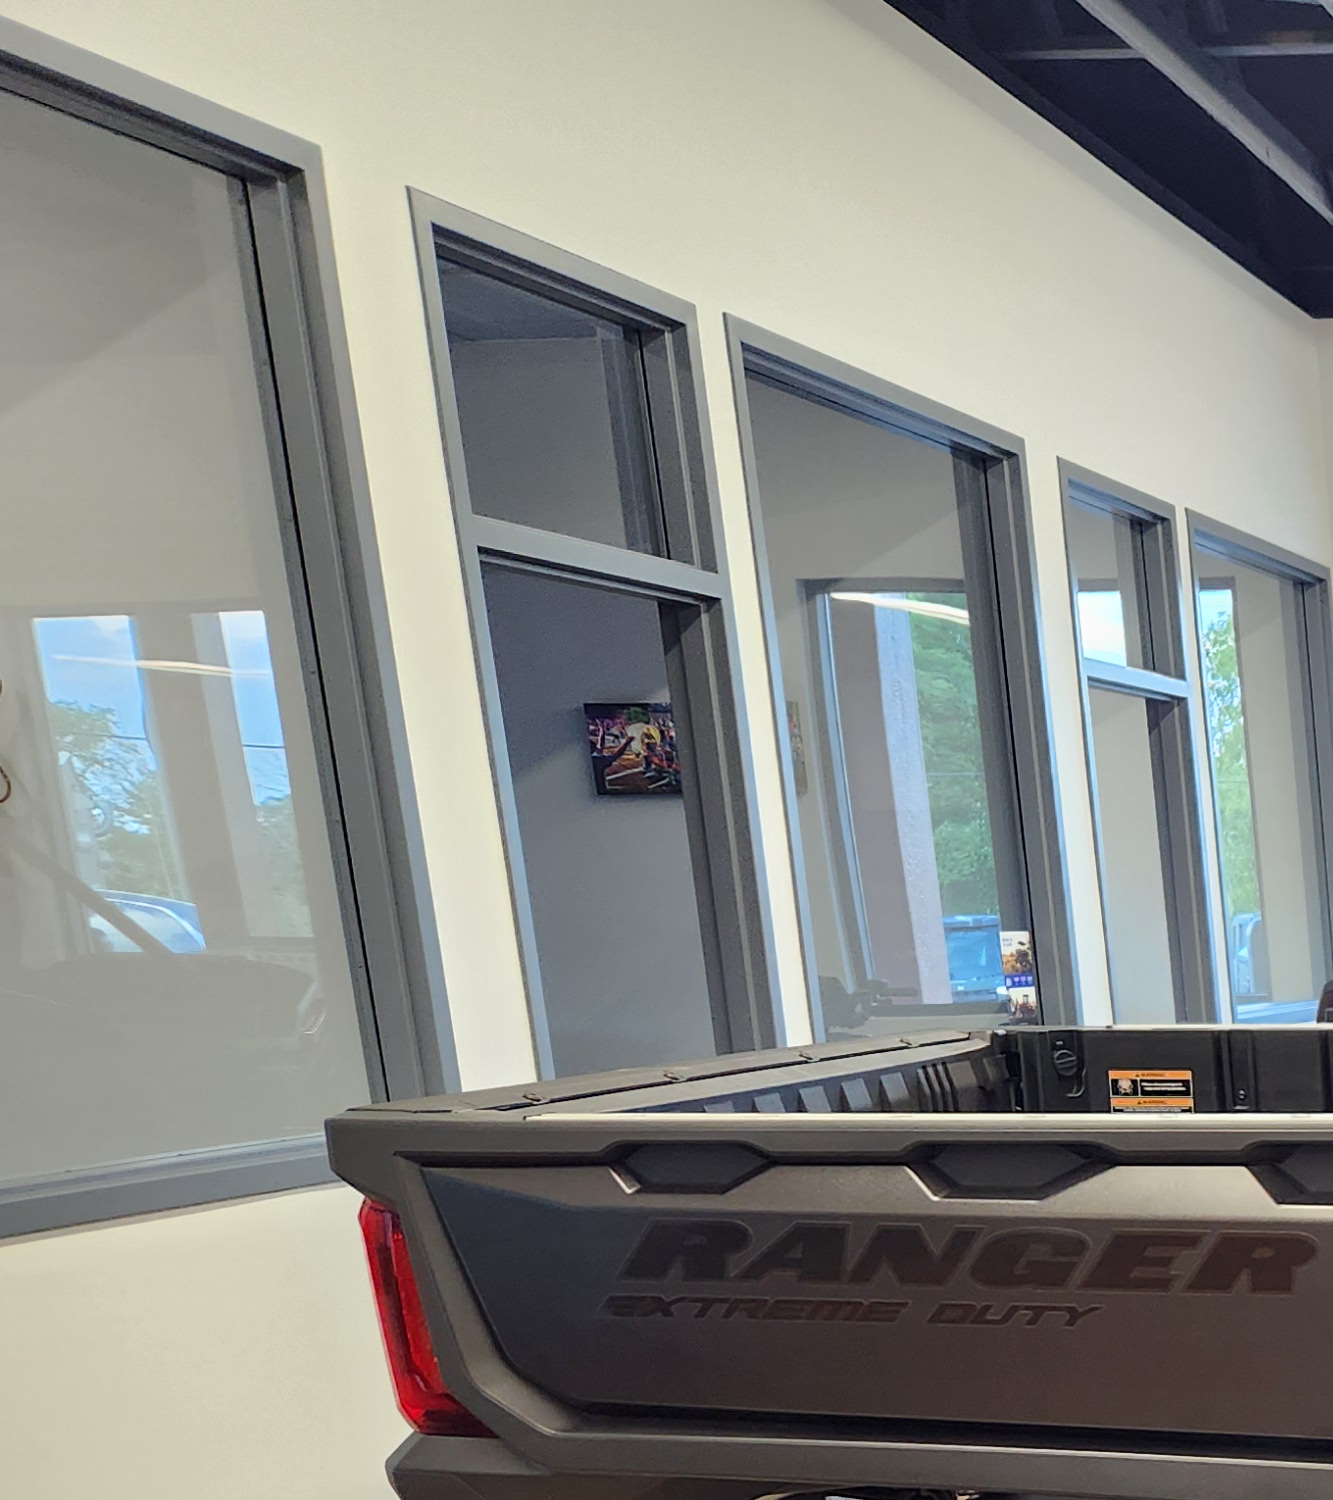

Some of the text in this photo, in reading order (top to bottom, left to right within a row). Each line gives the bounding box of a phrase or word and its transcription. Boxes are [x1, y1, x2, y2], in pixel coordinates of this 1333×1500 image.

[615, 1217, 1319, 1296] RANGER
[595, 1293, 1104, 1328] EXTREME DUTY
